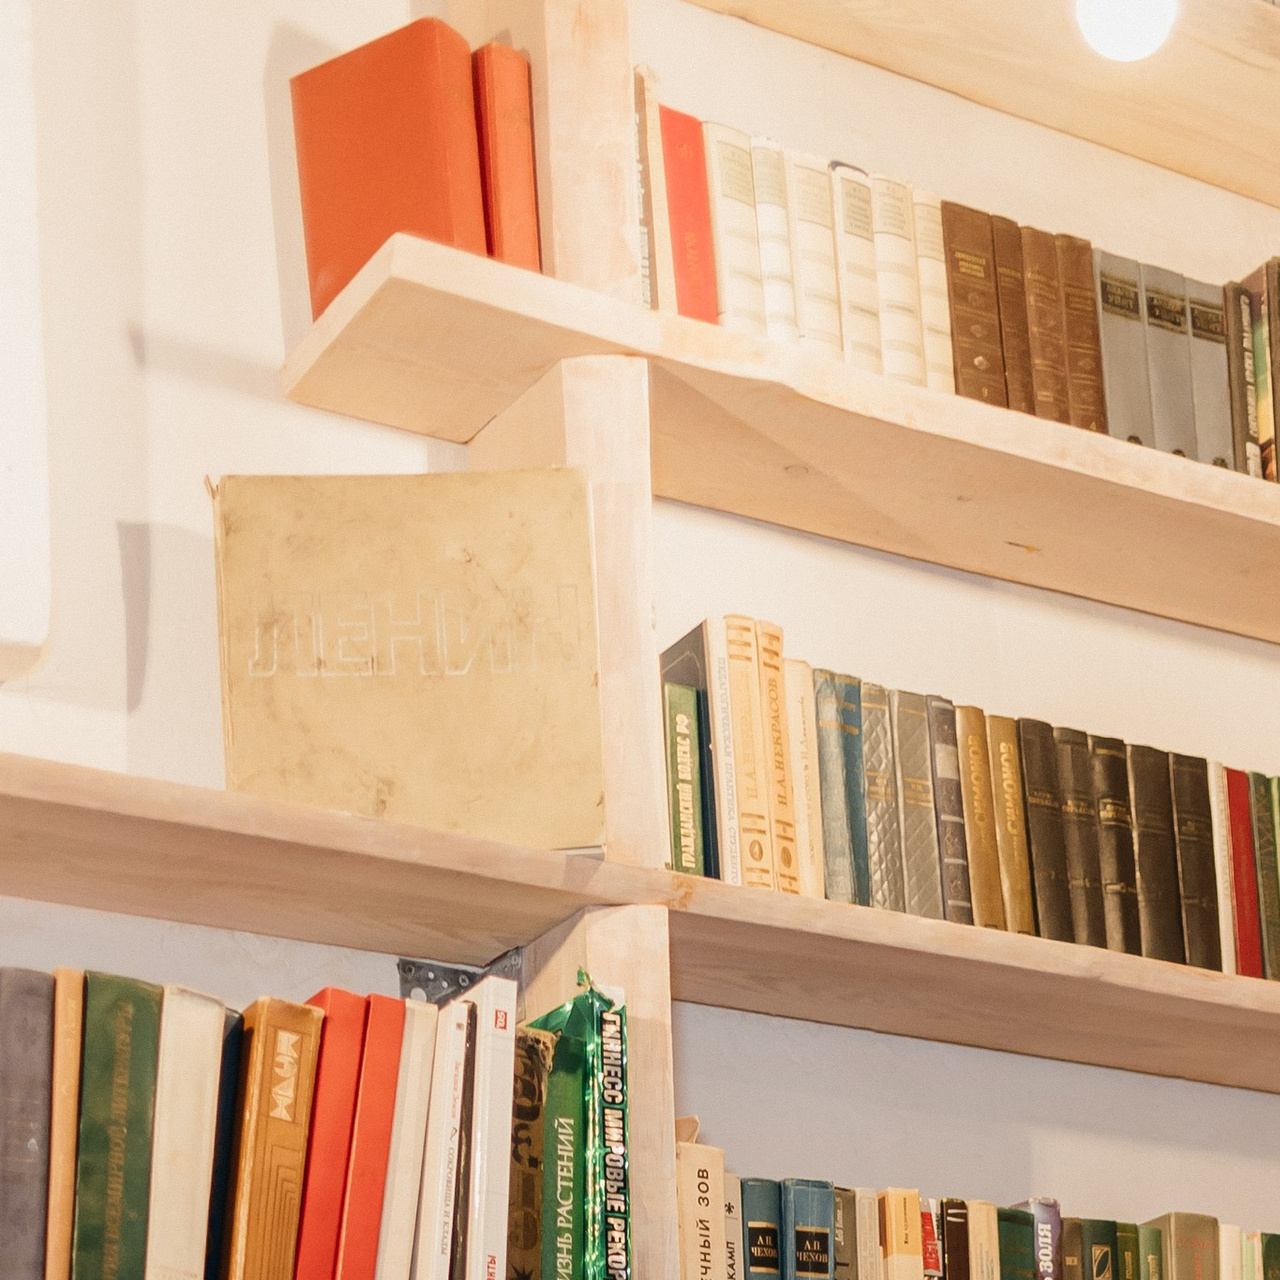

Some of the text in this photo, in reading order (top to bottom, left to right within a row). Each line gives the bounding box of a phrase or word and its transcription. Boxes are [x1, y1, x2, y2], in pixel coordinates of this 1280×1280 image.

[248, 582, 582, 680] ЛЕНИН
[717, 657, 735, 822] ПЕДАГОГИЧЕСКАЯ ПРАКТИКА
[676, 713, 696, 868] ГРАЖДАНСКИЙ КОДЕКС РФ
[106, 1002, 133, 1120] ЛИТЕРАТУРЫ
[601, 1011, 625, 1104] ГИННЕСС
[101, 1127, 126, 1241] ВСЕМИРНОЙ
[444, 1147, 456, 1206] СОКРОВИЩА
[554, 1118, 575, 1229] РАСТЕНИЙ
[603, 1109, 627, 1210] МИРОВЫЕ
[696, 1167, 710, 1206] ЗОВ
[727, 1241, 737, 1280] КАМП
[750, 1245, 778, 1259] ЧЕХОВ
[796, 1250, 828, 1264] ЧЕХОВ
[1037, 1223, 1052, 1272] ЗОЛЯ
